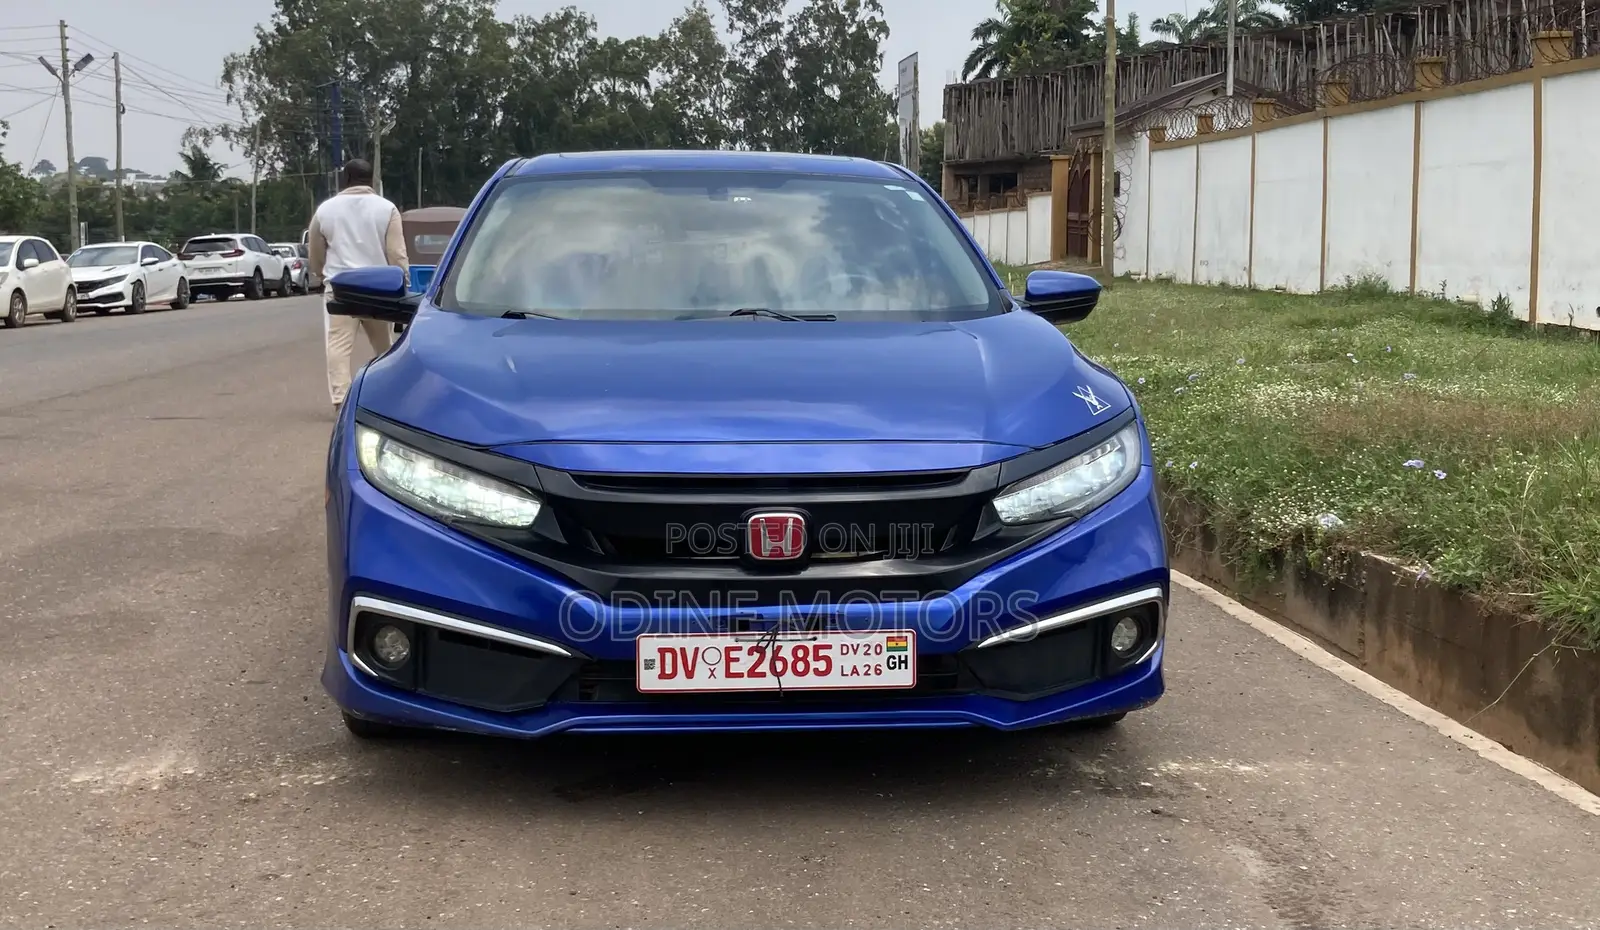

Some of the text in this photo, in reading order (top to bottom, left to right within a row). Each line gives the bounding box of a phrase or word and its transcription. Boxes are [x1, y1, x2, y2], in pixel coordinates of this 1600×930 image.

[840, 643, 883, 656] DV20
[657, 646, 699, 680] DV
[724, 643, 833, 679] E2685
[886, 654, 909, 671] GH
[840, 664, 883, 677] LA26
